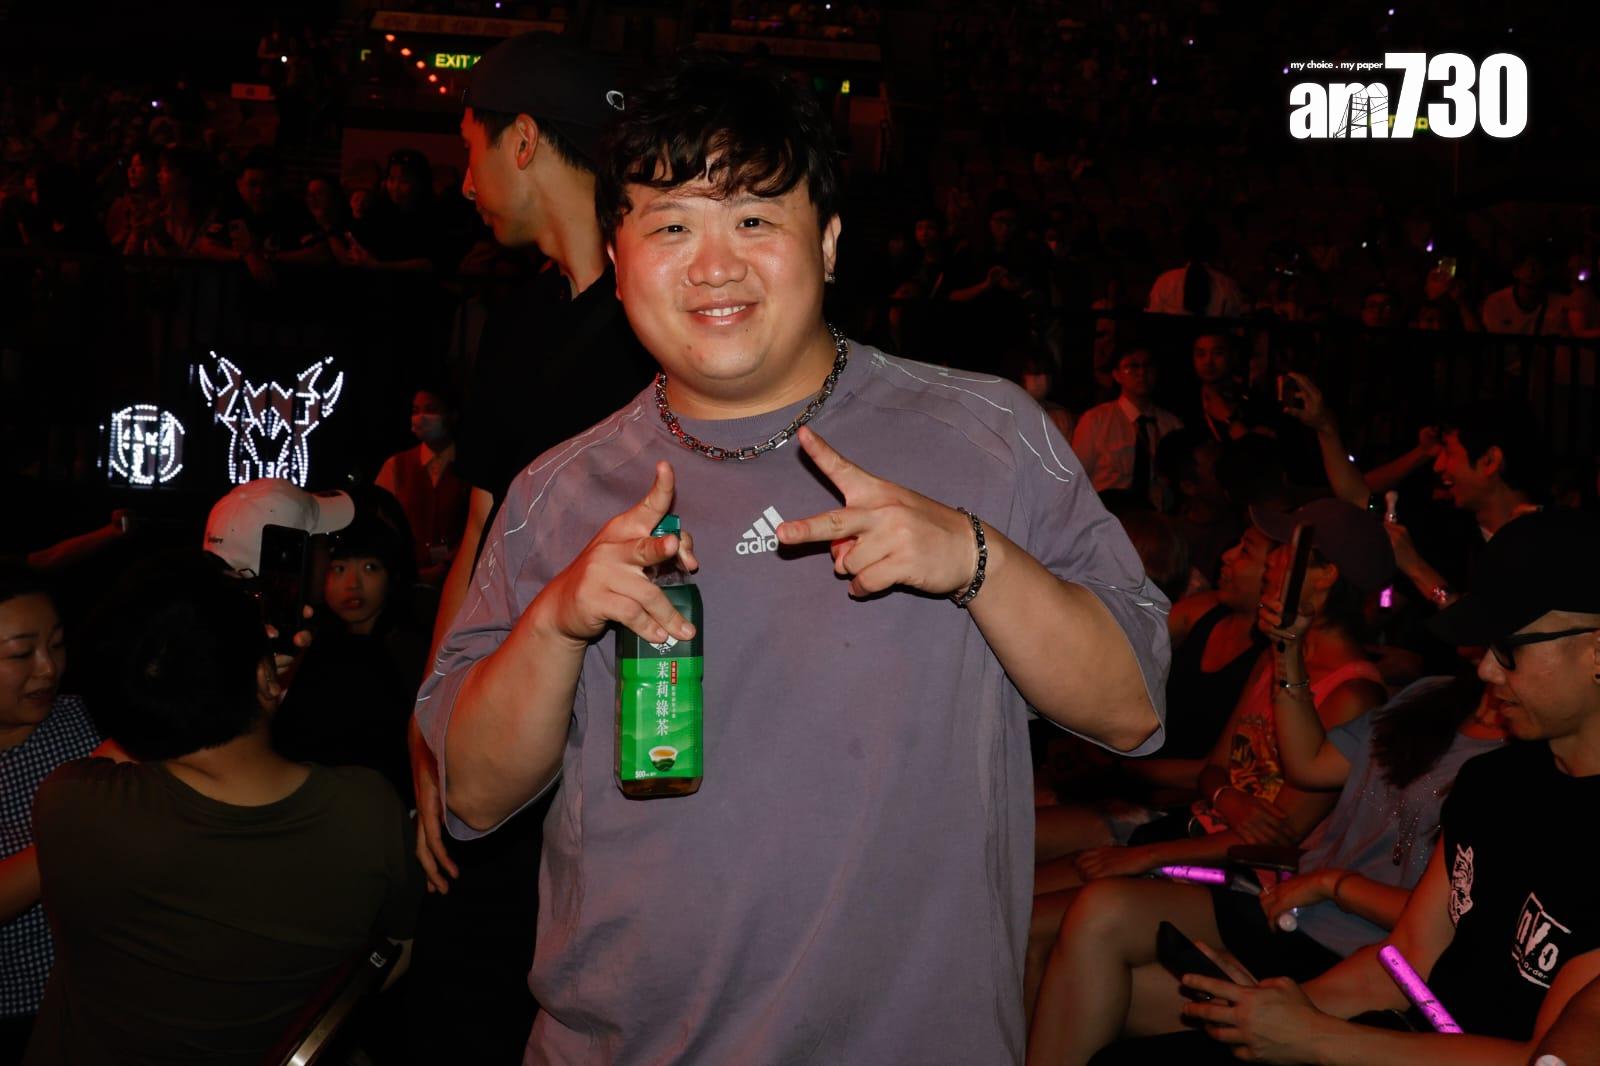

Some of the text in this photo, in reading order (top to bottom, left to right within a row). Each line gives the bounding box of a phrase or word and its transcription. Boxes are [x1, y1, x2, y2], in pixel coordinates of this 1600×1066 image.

[435, 53, 470, 68] EXIT
[735, 536, 779, 555] adid
[655, 660, 669, 737] 茉莉綠茶
[1523, 962, 1549, 979] order
